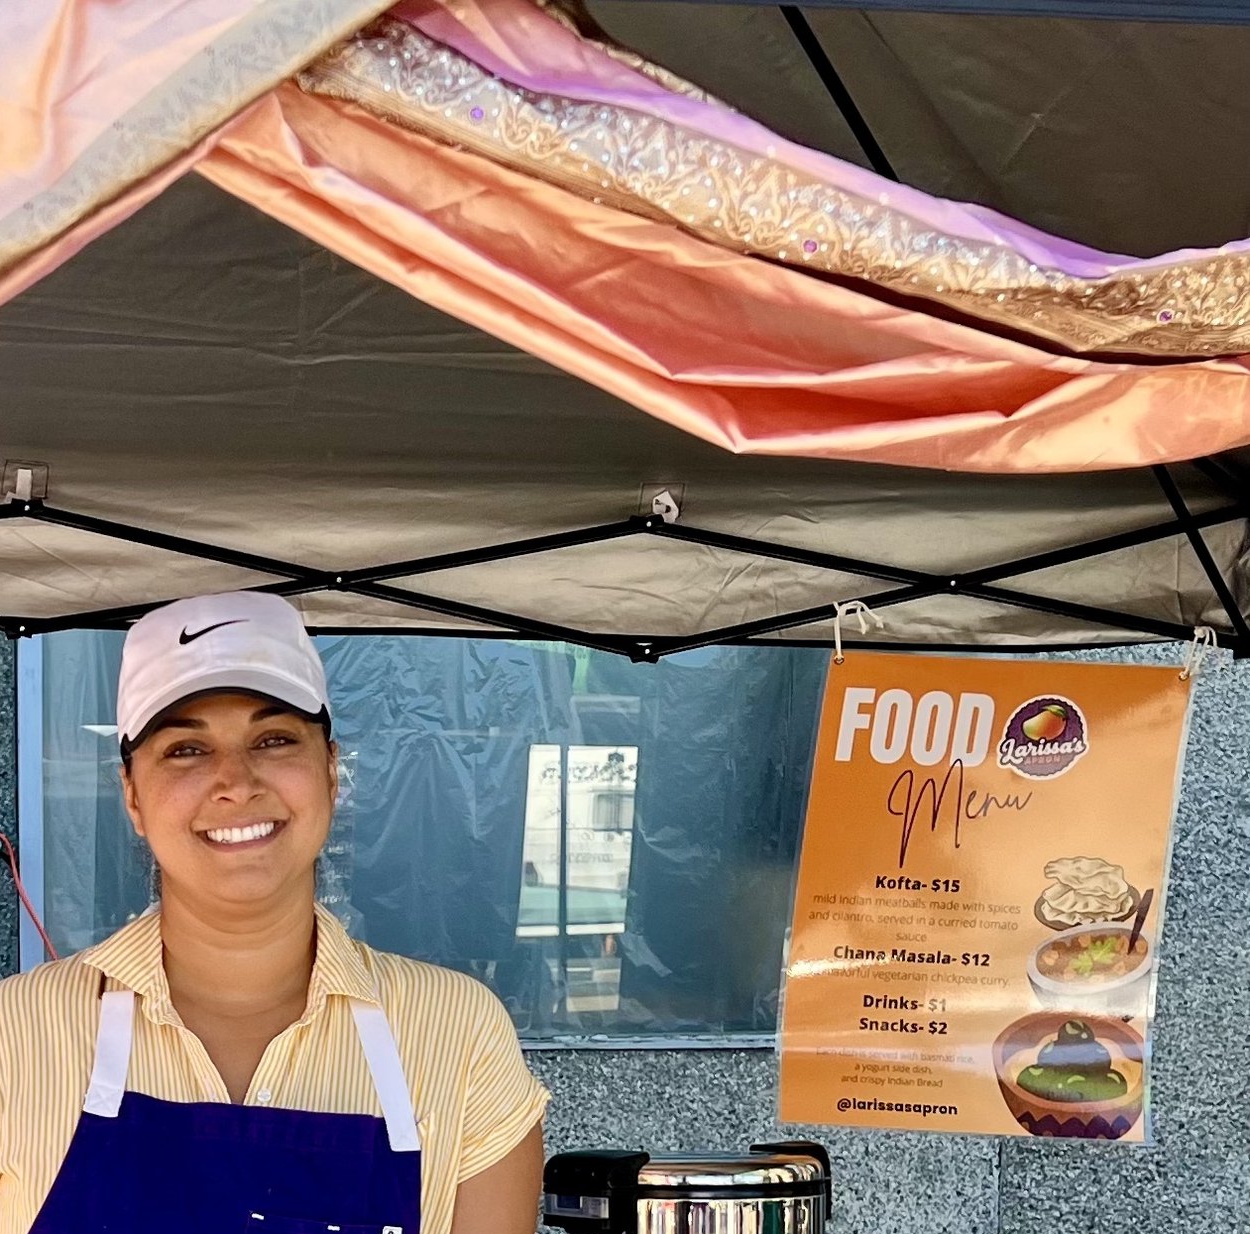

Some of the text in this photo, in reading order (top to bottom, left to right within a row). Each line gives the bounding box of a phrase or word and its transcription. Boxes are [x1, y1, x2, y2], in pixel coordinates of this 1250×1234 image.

[834, 687, 995, 767] FOOD
[1001, 737, 1087, 763] Larissa's
[888, 758, 1032, 868] Menu
[875, 876, 961, 893] Kofta- $15
[813, 893, 1021, 916] mild Indian meatballs made with spices
[808, 910, 830, 921] and
[878, 914, 914, 925] served
[916, 916, 926, 926] in
[928, 918, 936, 926] a
[938, 918, 977, 929] curried
[979, 920, 1019, 931] tomato
[895, 933, 928, 943] sauce
[833, 945, 991, 967] Chana Masala- $12
[872, 968, 928, 982] vegetarian
[930, 971, 978, 985] chickpea
[863, 994, 947, 1013] Drinks- $1
[859, 1017, 948, 1035] Snacks- $2
[861, 1063, 890, 1074] yogurt
[892, 1063, 910, 1073] side
[841, 1074, 943, 1087] and crispy Indian Bread
[837, 1097, 958, 1116] @larissasapron
